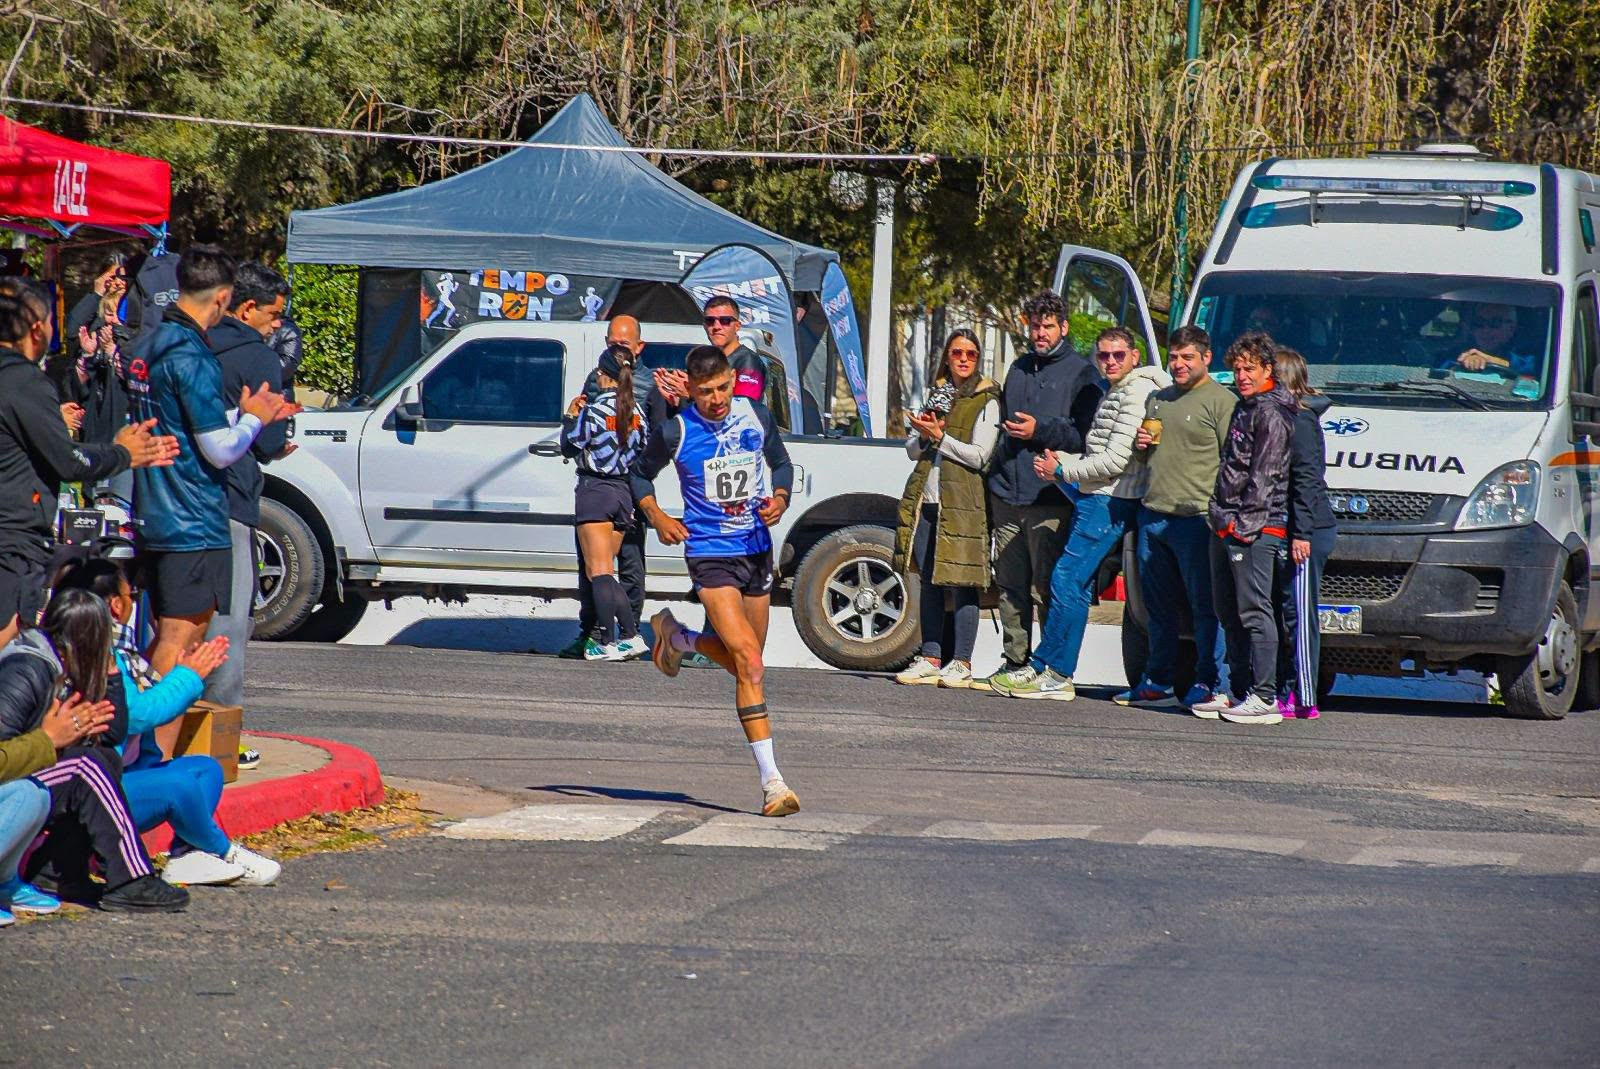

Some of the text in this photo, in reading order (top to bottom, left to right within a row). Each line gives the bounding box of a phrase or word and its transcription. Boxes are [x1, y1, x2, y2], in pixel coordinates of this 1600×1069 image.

[469, 268, 569, 295] TEMPO
[478, 291, 553, 320] RUN
[716, 470, 749, 500] 62
